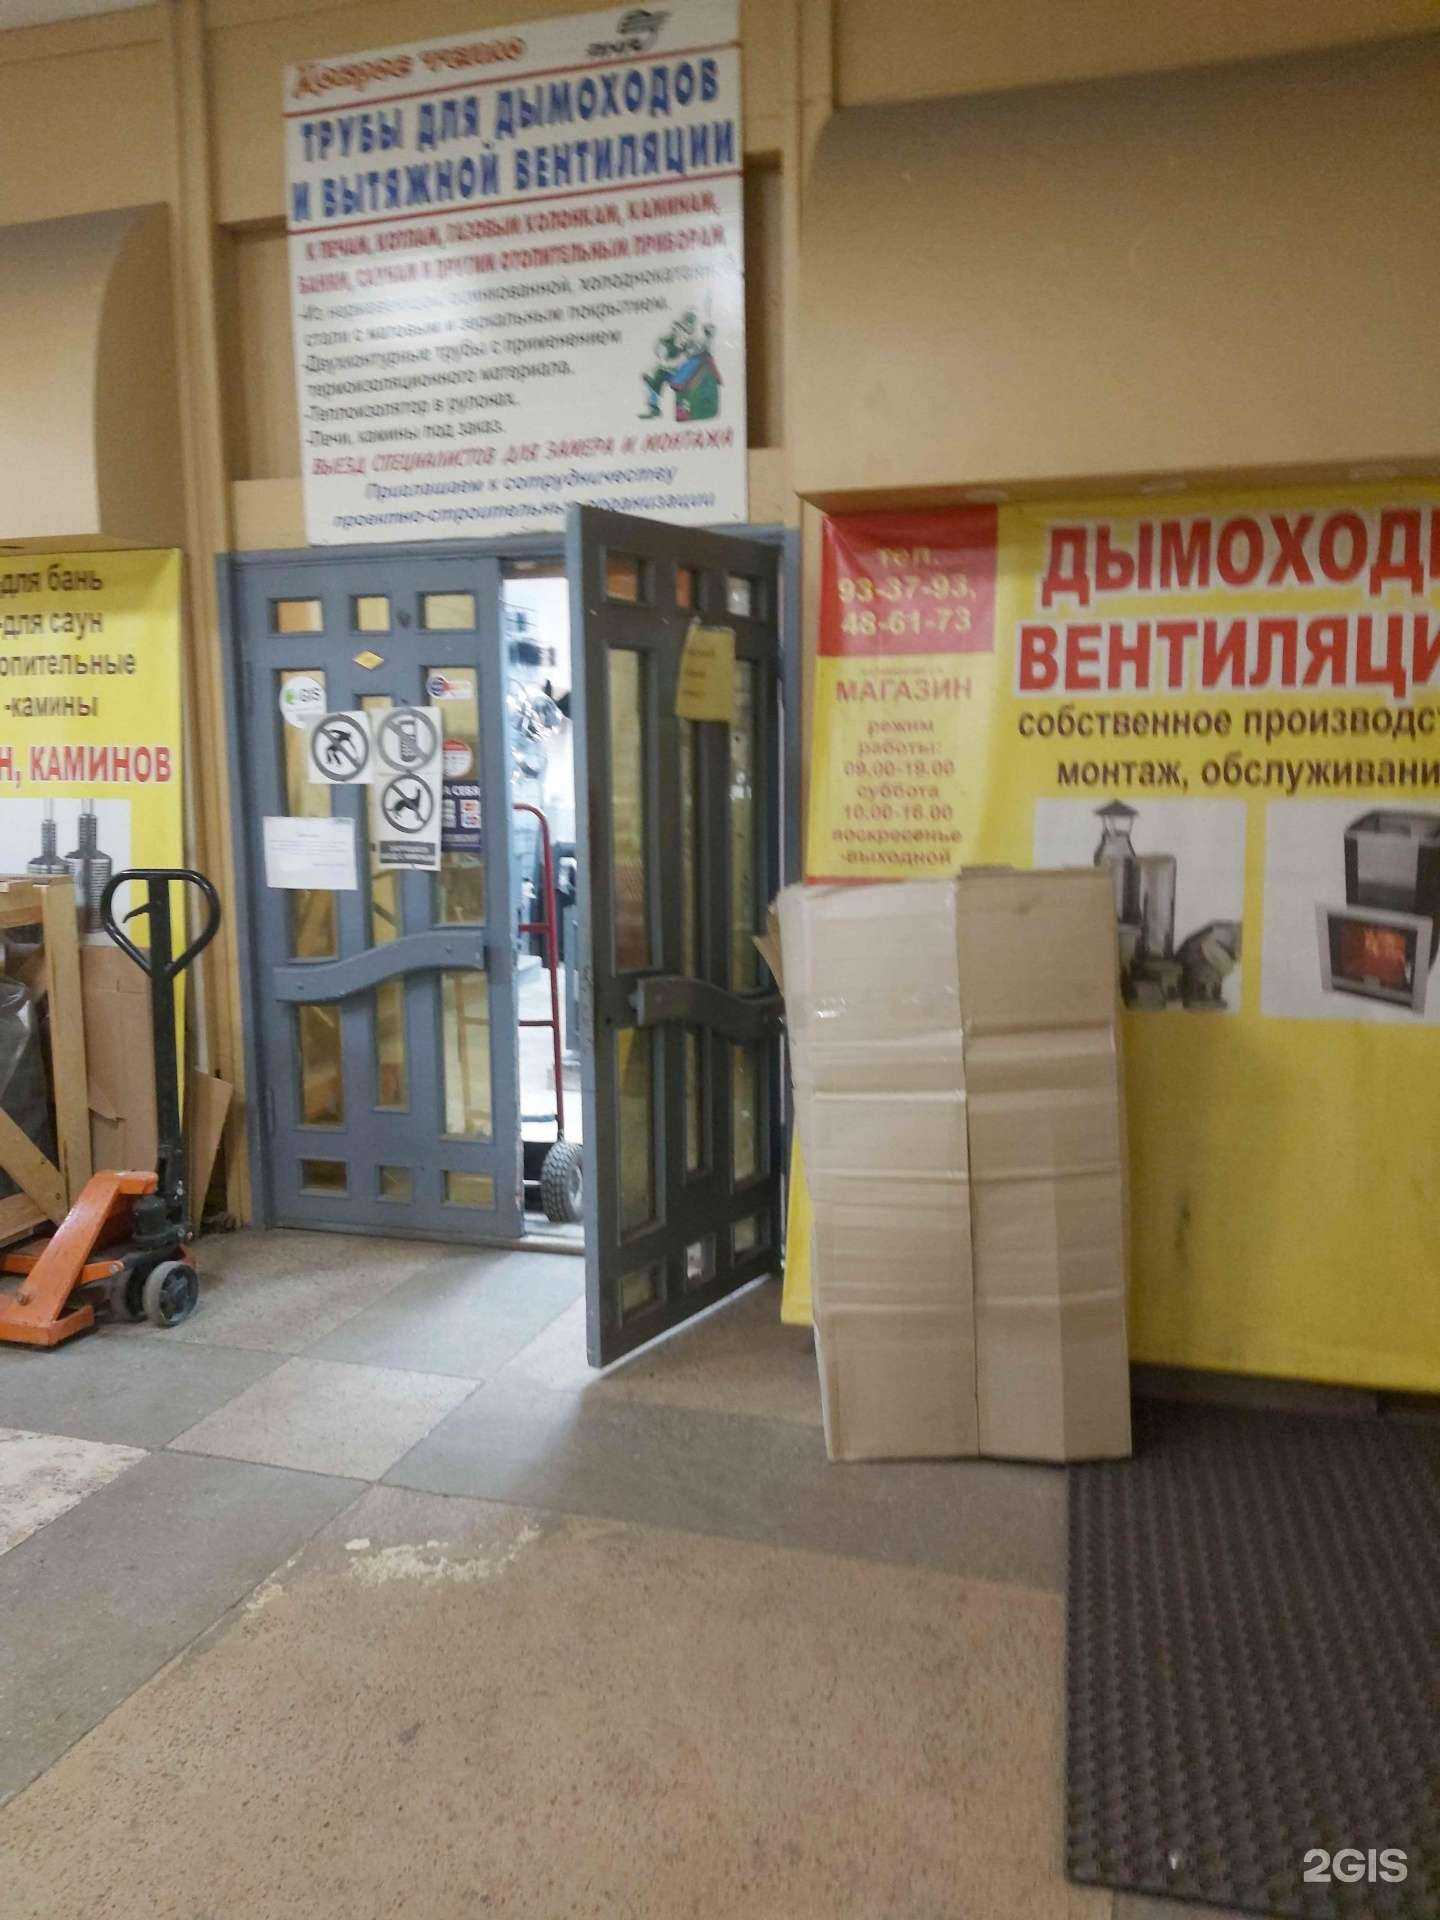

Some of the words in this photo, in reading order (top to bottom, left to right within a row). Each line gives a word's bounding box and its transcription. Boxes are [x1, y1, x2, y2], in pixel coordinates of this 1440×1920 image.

[303, 107, 404, 162] ТРУБЫ
[416, 95, 481, 152] ДЛЯ
[494, 57, 720, 141] ДЫМОХОДОВ
[292, 181, 312, 223] И
[322, 142, 500, 219] ВЫТЯЖНОЙ
[513, 118, 736, 192] ВЕНТИЛЯЦИИ
[311, 455, 366, 476] ВЫЕЗД
[370, 445, 497, 473] СПЕЦИАЛИСТОВ
[1041, 508, 1440, 608] ДЫМОХОД
[48, 563, 104, 592] бань
[50, 611, 104, 641] саун
[835, 676, 973, 704] МАГАЗИН
[1018, 703, 1233, 739] собственное
[1243, 705, 1440, 745] производс
[29, 745, 172, 784] КАМИНОВ
[1056, 758, 1190, 793] монтаж,
[856, 783, 940, 801] суббота
